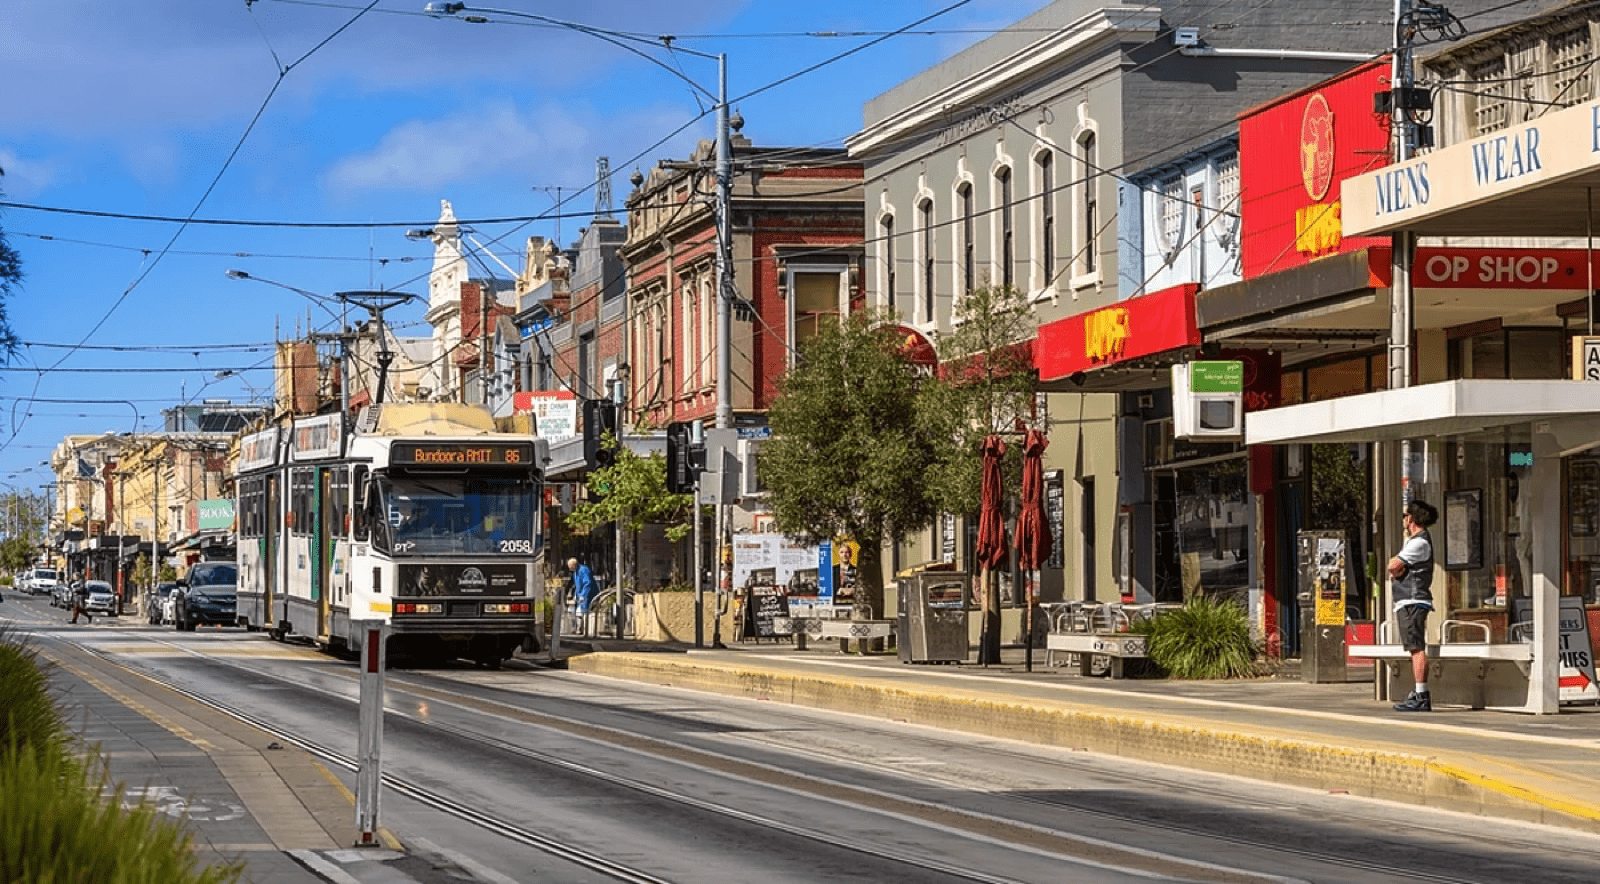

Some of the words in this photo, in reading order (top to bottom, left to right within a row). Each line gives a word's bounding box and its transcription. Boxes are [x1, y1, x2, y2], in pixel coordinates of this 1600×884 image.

[1375, 161, 1431, 216] MENS
[1471, 127, 1542, 186] WEAR
[1425, 255, 1470, 282] OP
[1478, 255, 1559, 284] SHOP
[415, 448, 465, 463] Bundoora
[505, 449, 520, 463] 86
[500, 539, 530, 553] 2058
